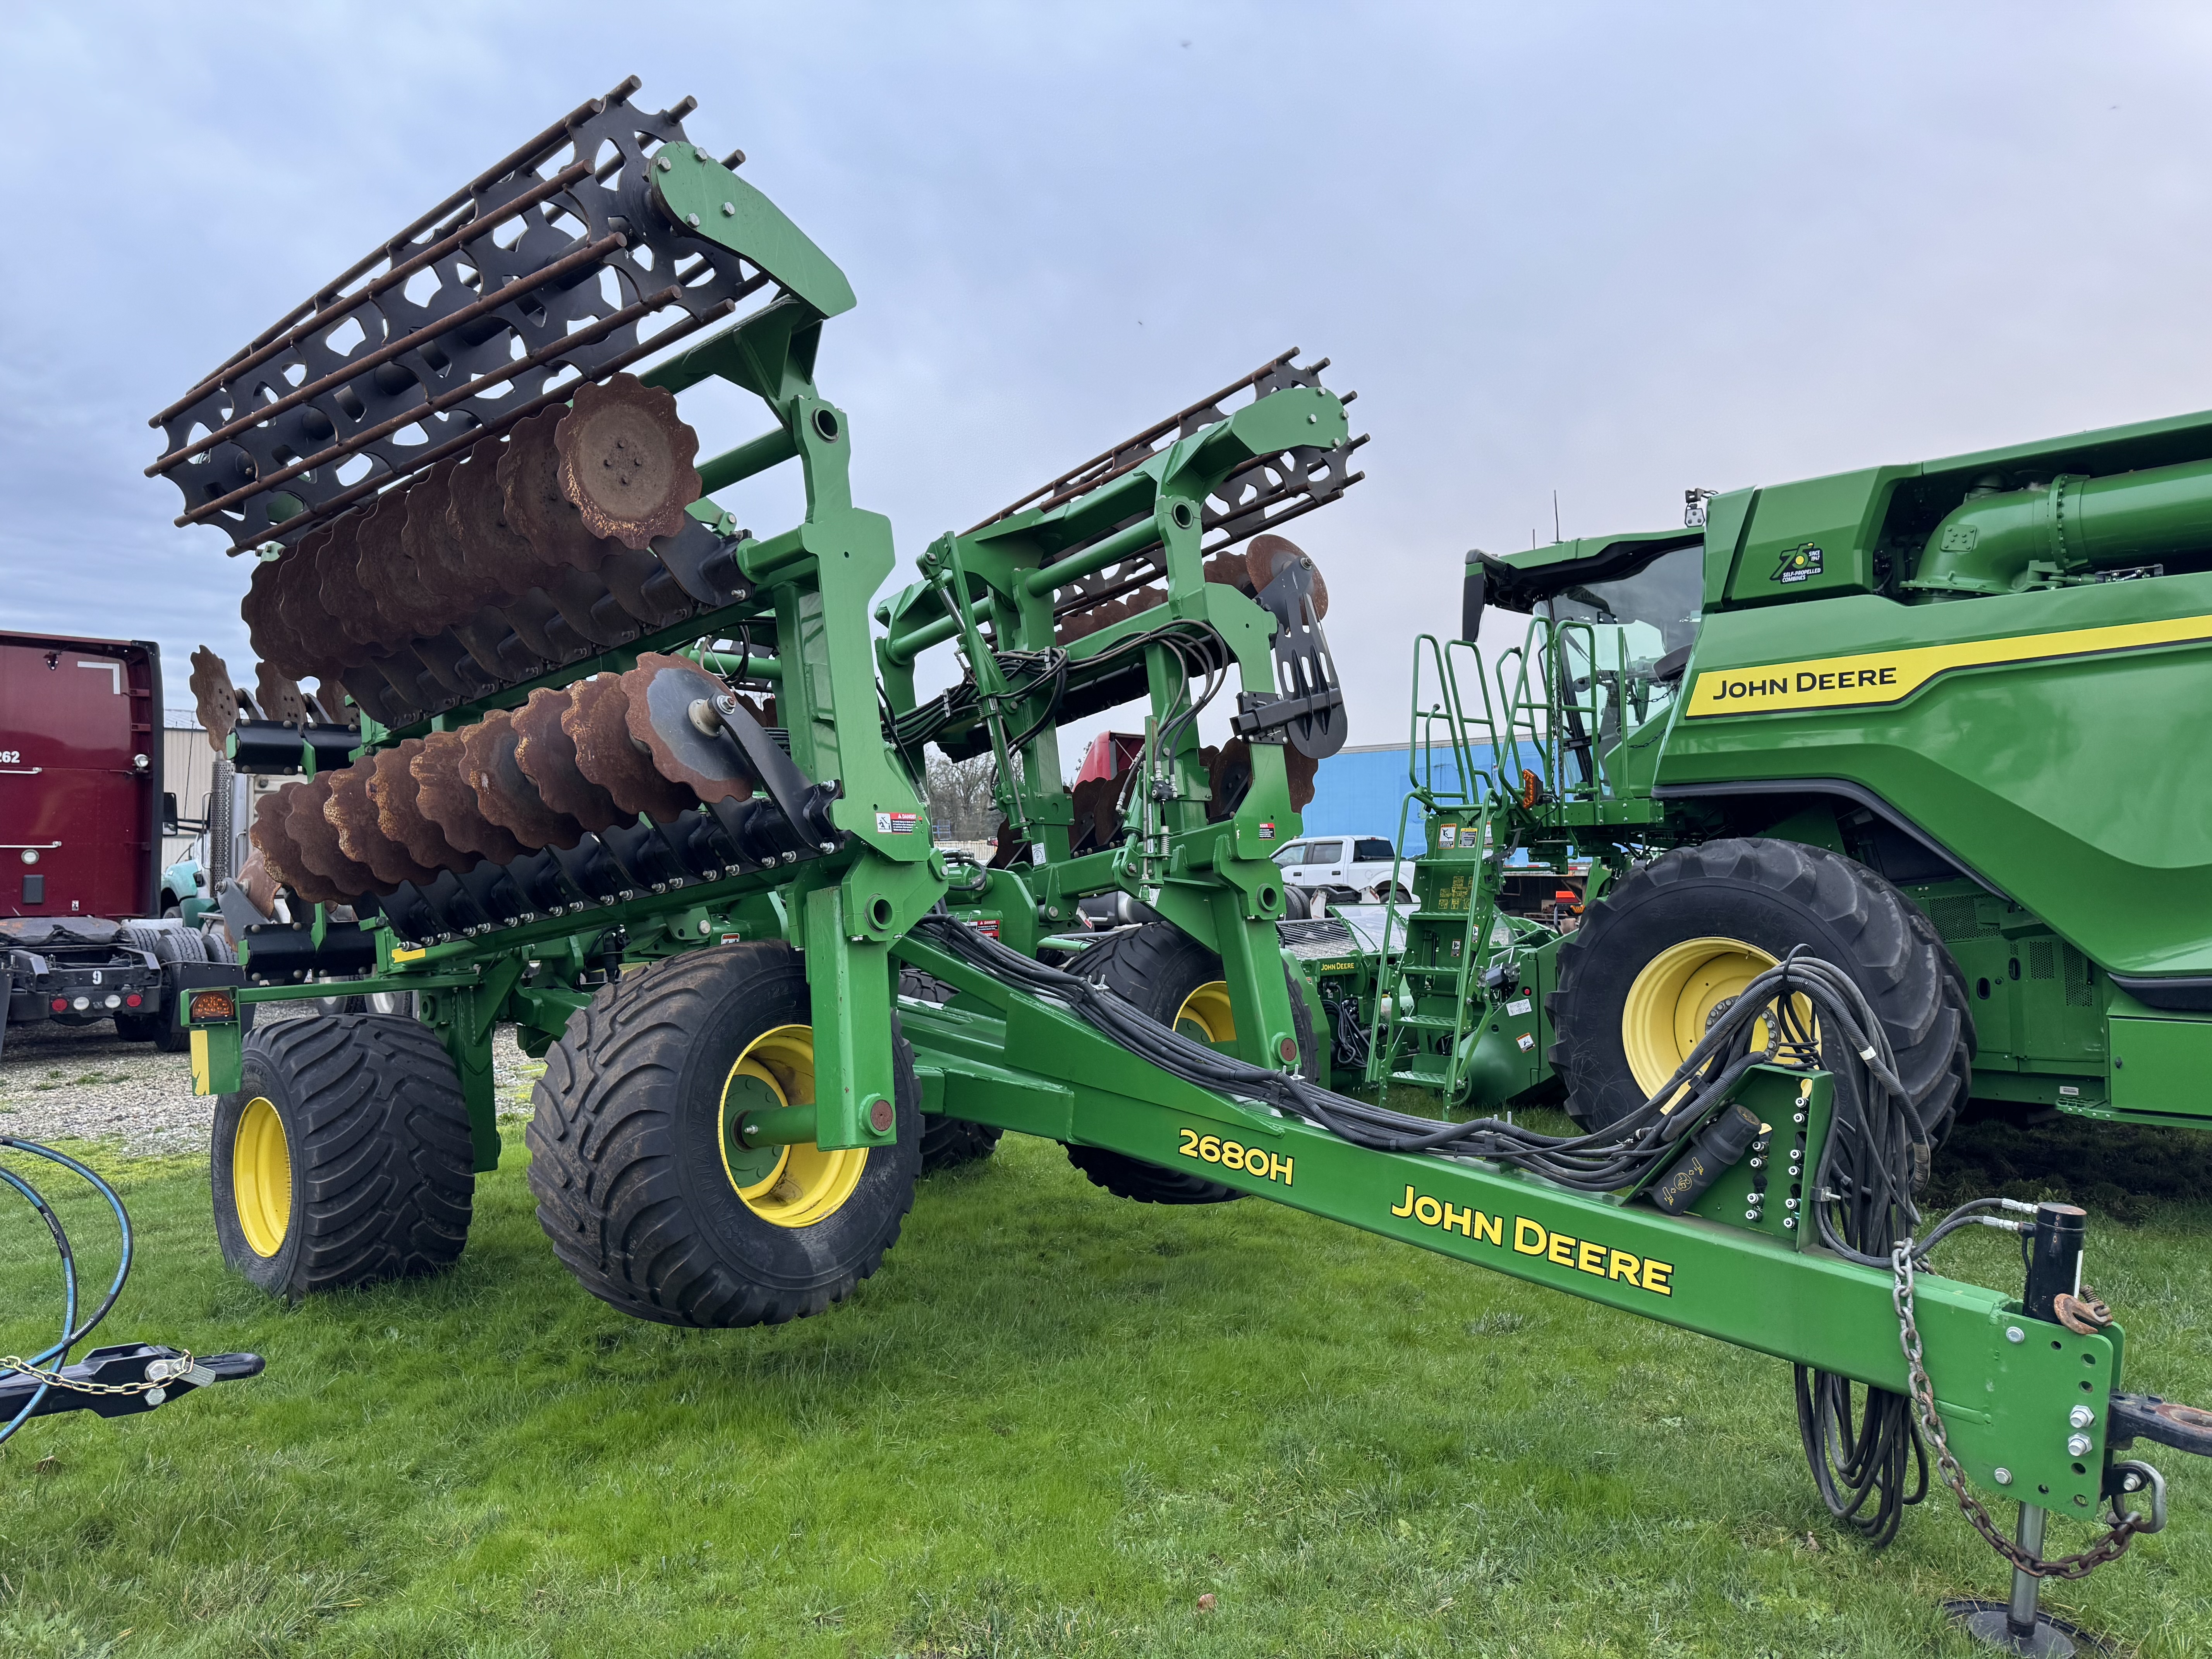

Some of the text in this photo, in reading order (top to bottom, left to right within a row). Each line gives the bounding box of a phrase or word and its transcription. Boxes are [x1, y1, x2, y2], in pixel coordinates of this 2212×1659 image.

[1783, 568, 1821, 577] SELF-PROPELLED
[1713, 667, 1896, 700] JOHN DEERE
[0, 751, 20, 763] 62
[93, 970, 102, 985] 9
[1178, 1128, 1294, 1187] 2680H
[1391, 1184, 1674, 1297] JOHN DEERE
[71, 1320, 92, 1340] Continental
